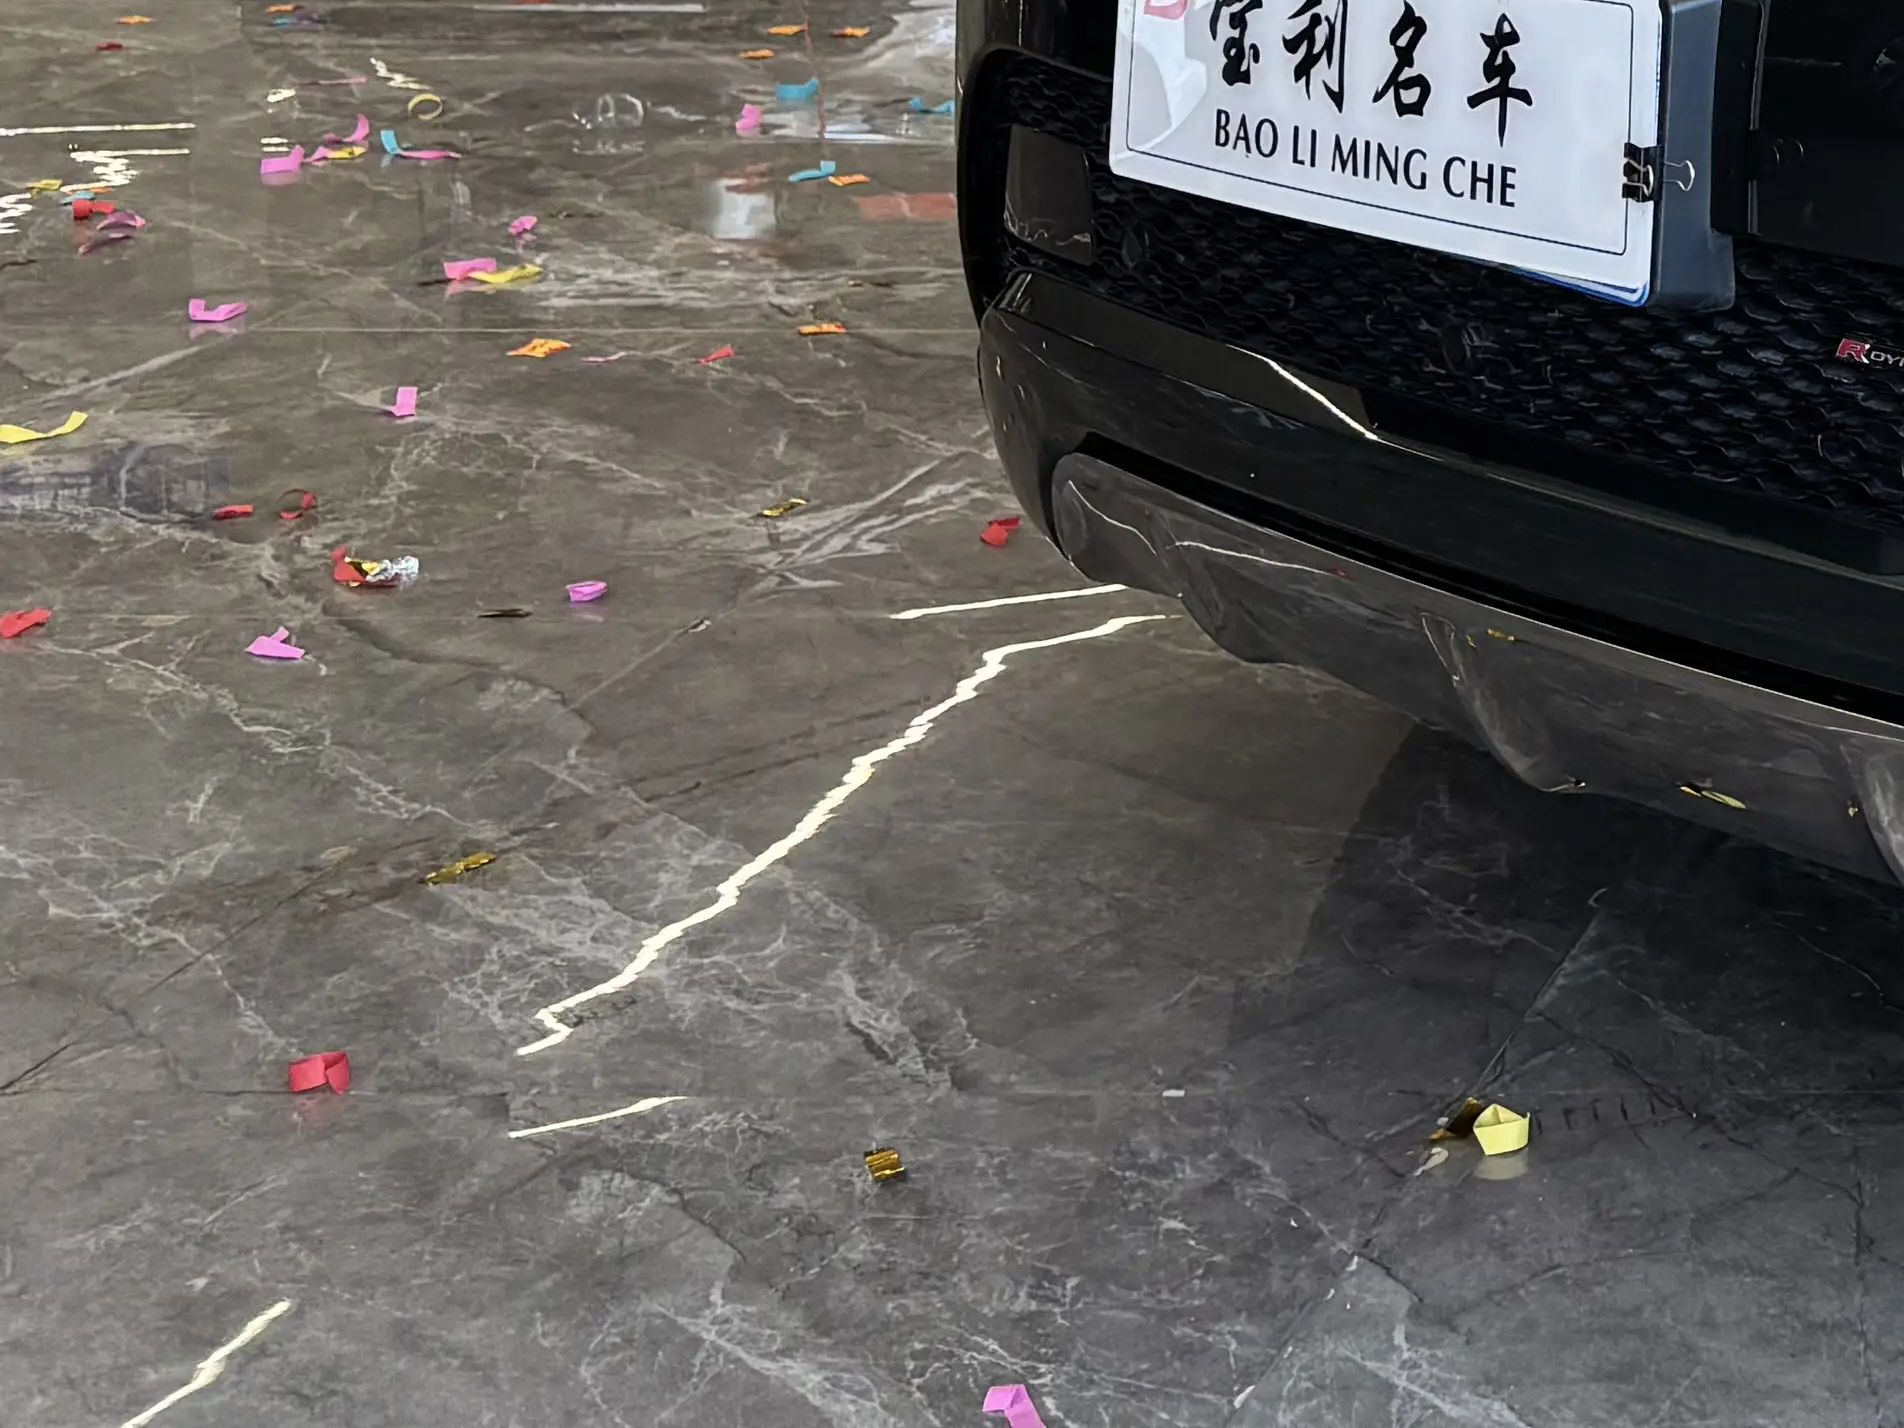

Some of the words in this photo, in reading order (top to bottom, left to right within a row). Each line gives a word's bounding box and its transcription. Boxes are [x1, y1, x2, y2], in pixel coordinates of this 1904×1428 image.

[1214, 108, 1280, 158] BAO
[1291, 124, 1318, 169] LI
[1330, 139, 1428, 191] MING
[1443, 155, 1517, 209] CHE
